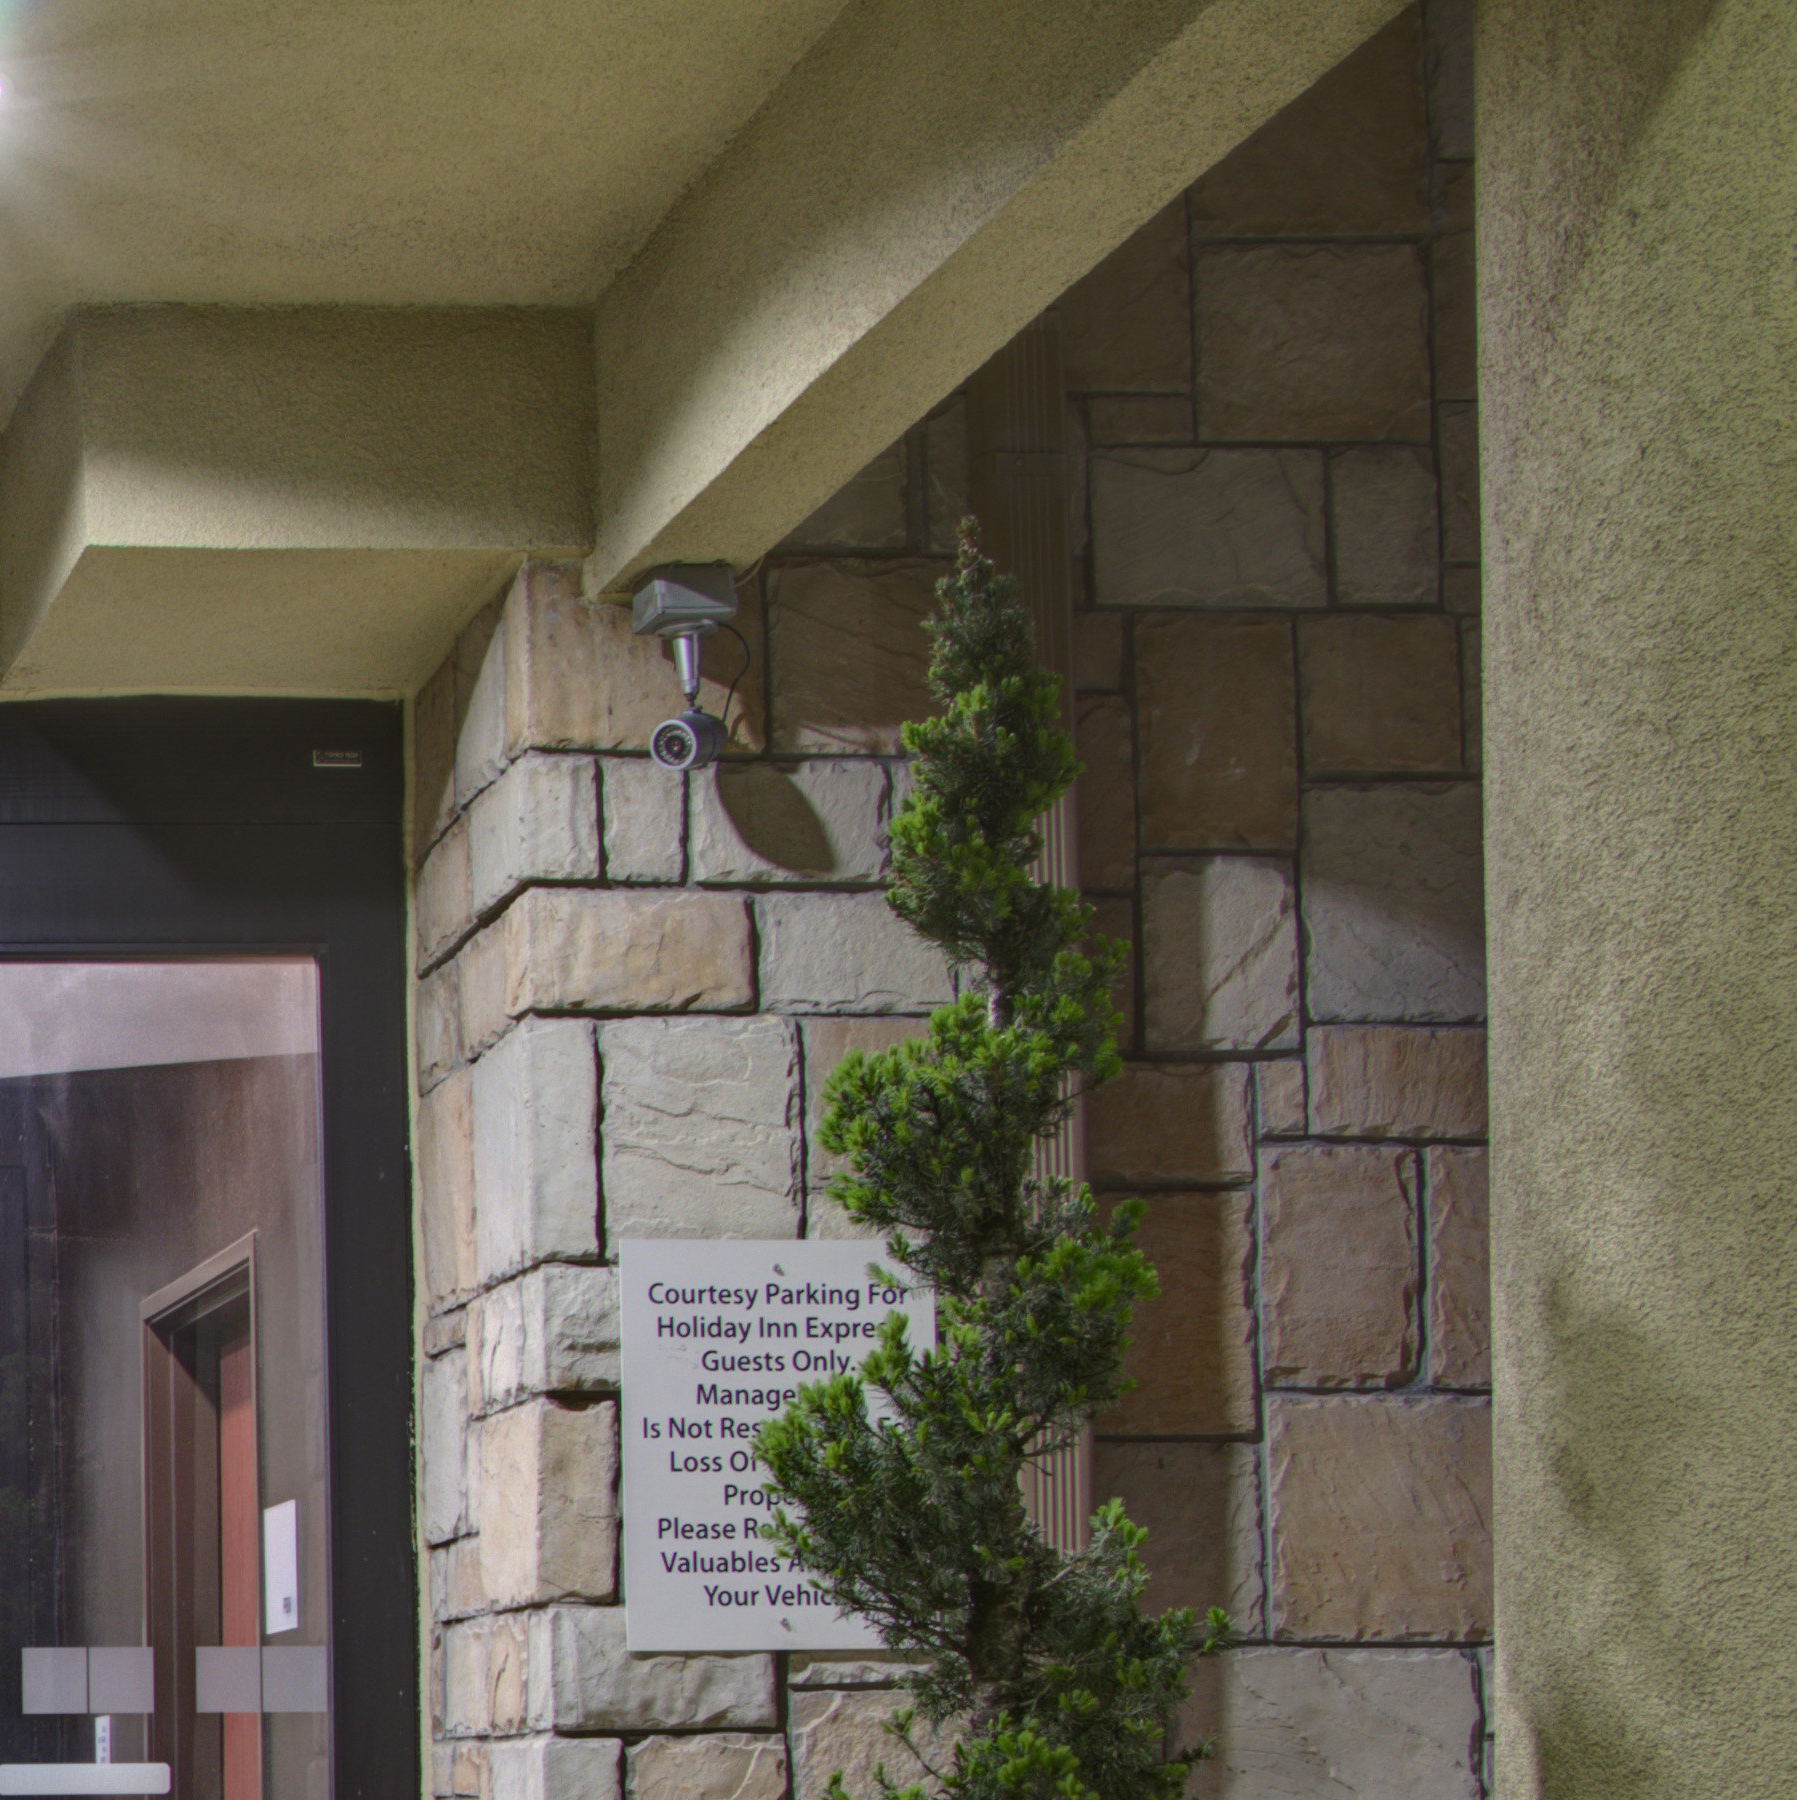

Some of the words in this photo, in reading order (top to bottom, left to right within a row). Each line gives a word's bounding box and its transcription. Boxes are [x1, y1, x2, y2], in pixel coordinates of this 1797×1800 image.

[648, 1282, 758, 1311] Courtesy
[765, 1282, 860, 1311] Parking
[868, 1284, 911, 1305] For
[657, 1315, 752, 1344] Holiday
[759, 1316, 798, 1338] Inn
[806, 1317, 876, 1344] Expre
[701, 1350, 785, 1372] Guests
[792, 1350, 856, 1377] Only.
[696, 1383, 797, 1413] Manage
[643, 1417, 661, 1439] Is
[668, 1417, 713, 1439] Not
[670, 1451, 723, 1473] Loss
[658, 1517, 736, 1540] Please
[661, 1550, 783, 1573] Valuables
[703, 1585, 760, 1607] Your
[764, 1584, 833, 1607] Vehic
